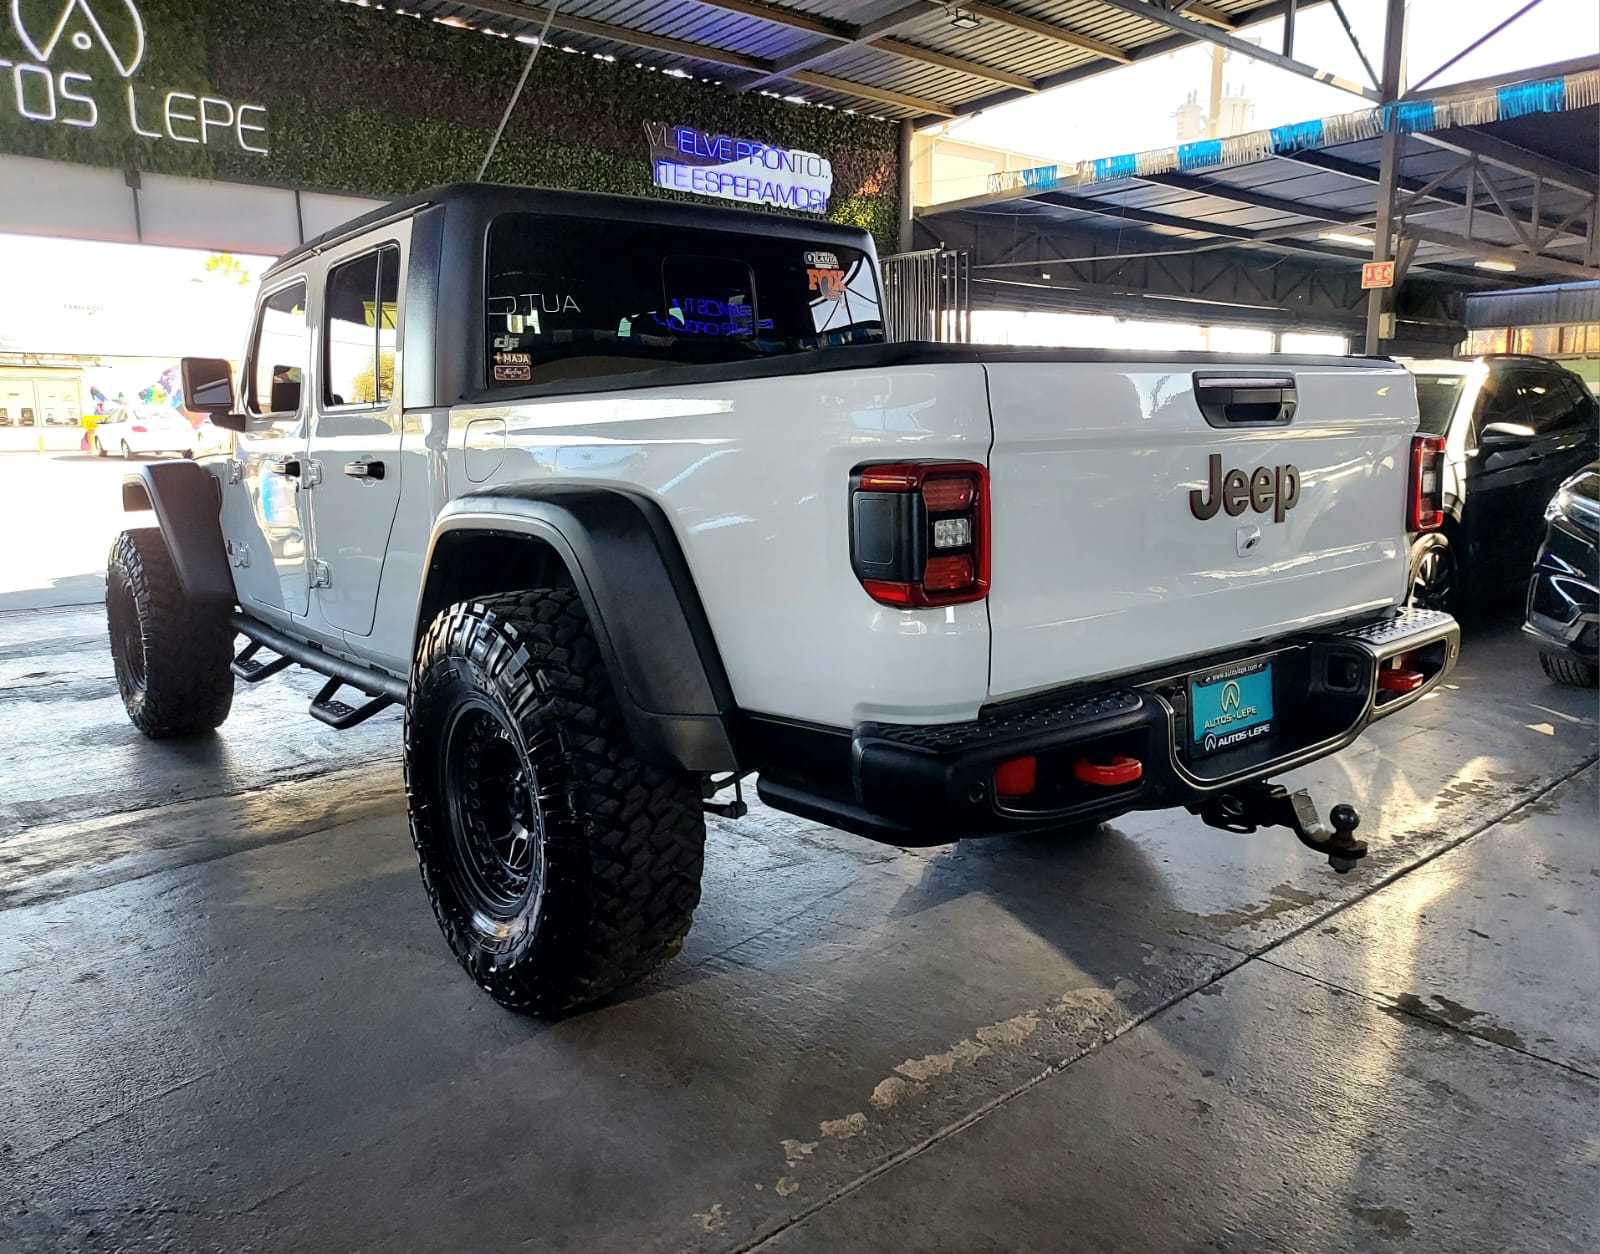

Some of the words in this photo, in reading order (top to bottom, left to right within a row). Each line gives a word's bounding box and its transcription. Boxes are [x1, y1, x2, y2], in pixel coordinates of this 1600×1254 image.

[128, 83, 269, 155] LEPE
[806, 268, 847, 299] FOX
[1189, 454, 1301, 523] Jeep
